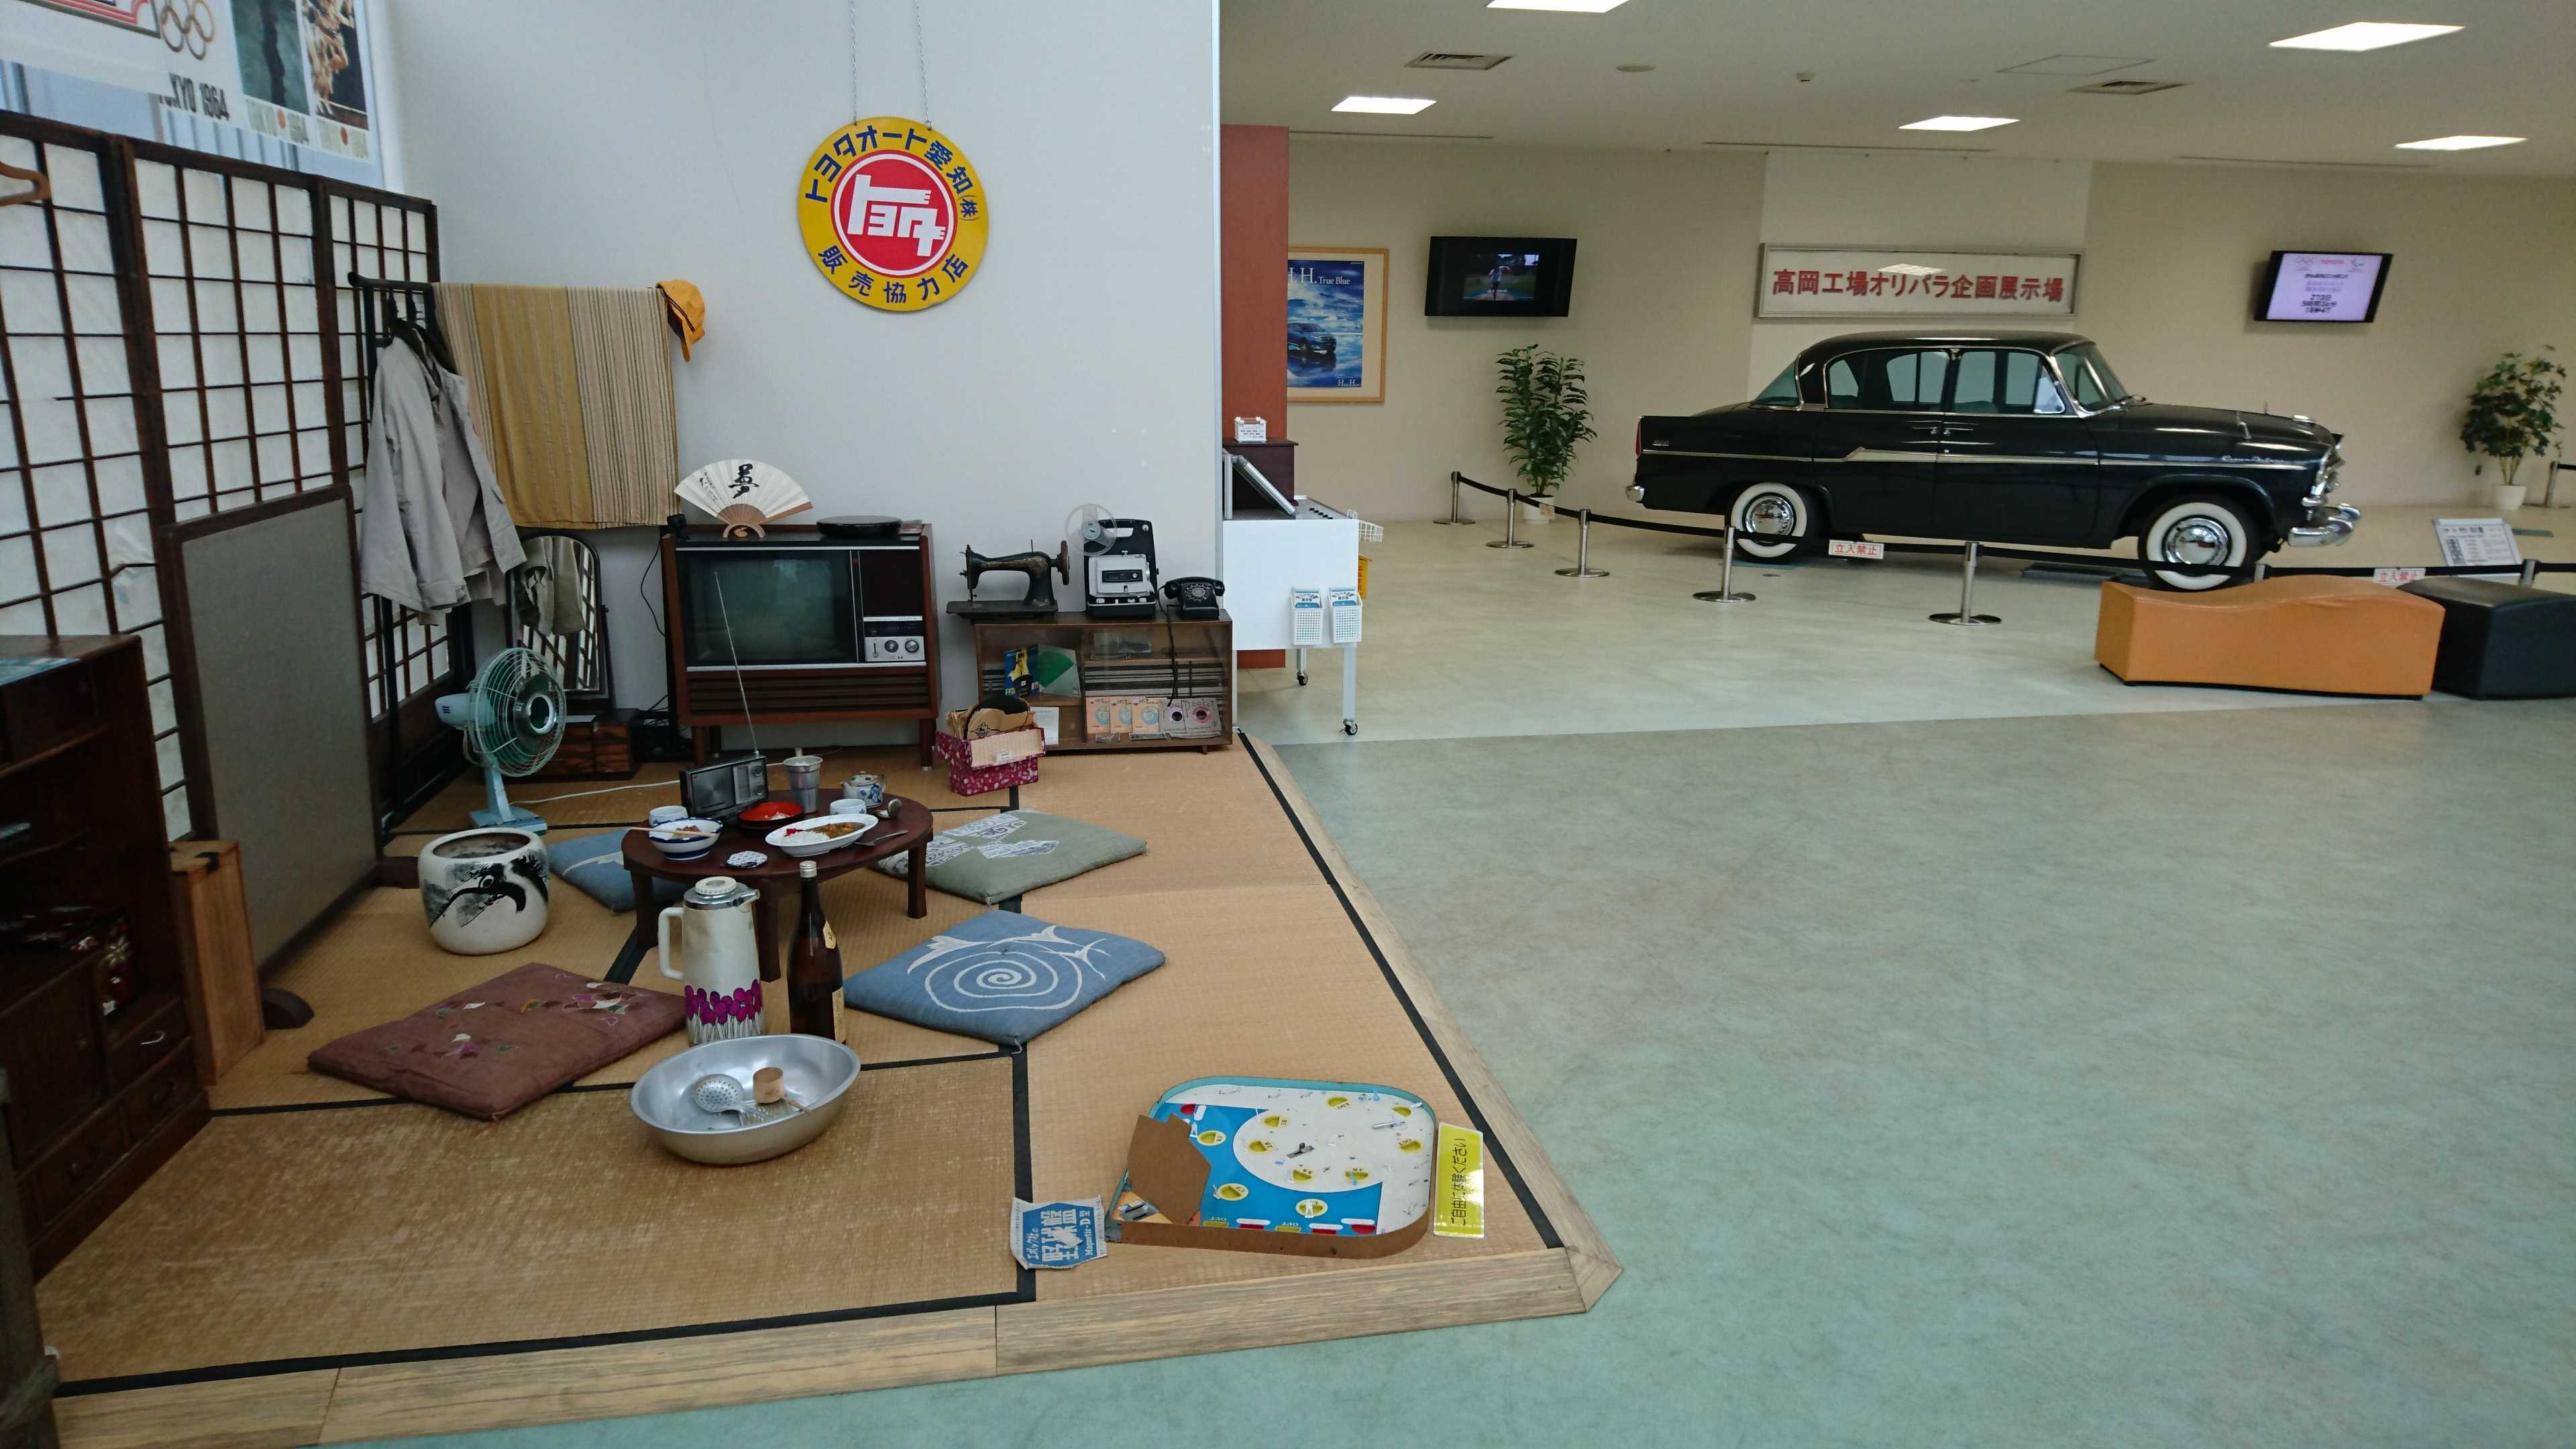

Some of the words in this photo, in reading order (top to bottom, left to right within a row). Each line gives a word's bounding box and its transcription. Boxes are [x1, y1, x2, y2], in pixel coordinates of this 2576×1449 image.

[199, 82, 230, 120] 1964
[818, 245, 969, 303] 販売協力店
[1318, 276, 1334, 284] True
[1336, 276, 1350, 284] Blue
[1772, 269, 2064, 302] 高岡工場オリパラ企画展示場
[1835, 543, 1878, 555] 立入禁止
[2379, 569, 2420, 582] 立入禁止
[1451, 1138, 1467, 1226] ご自由に体験ください
